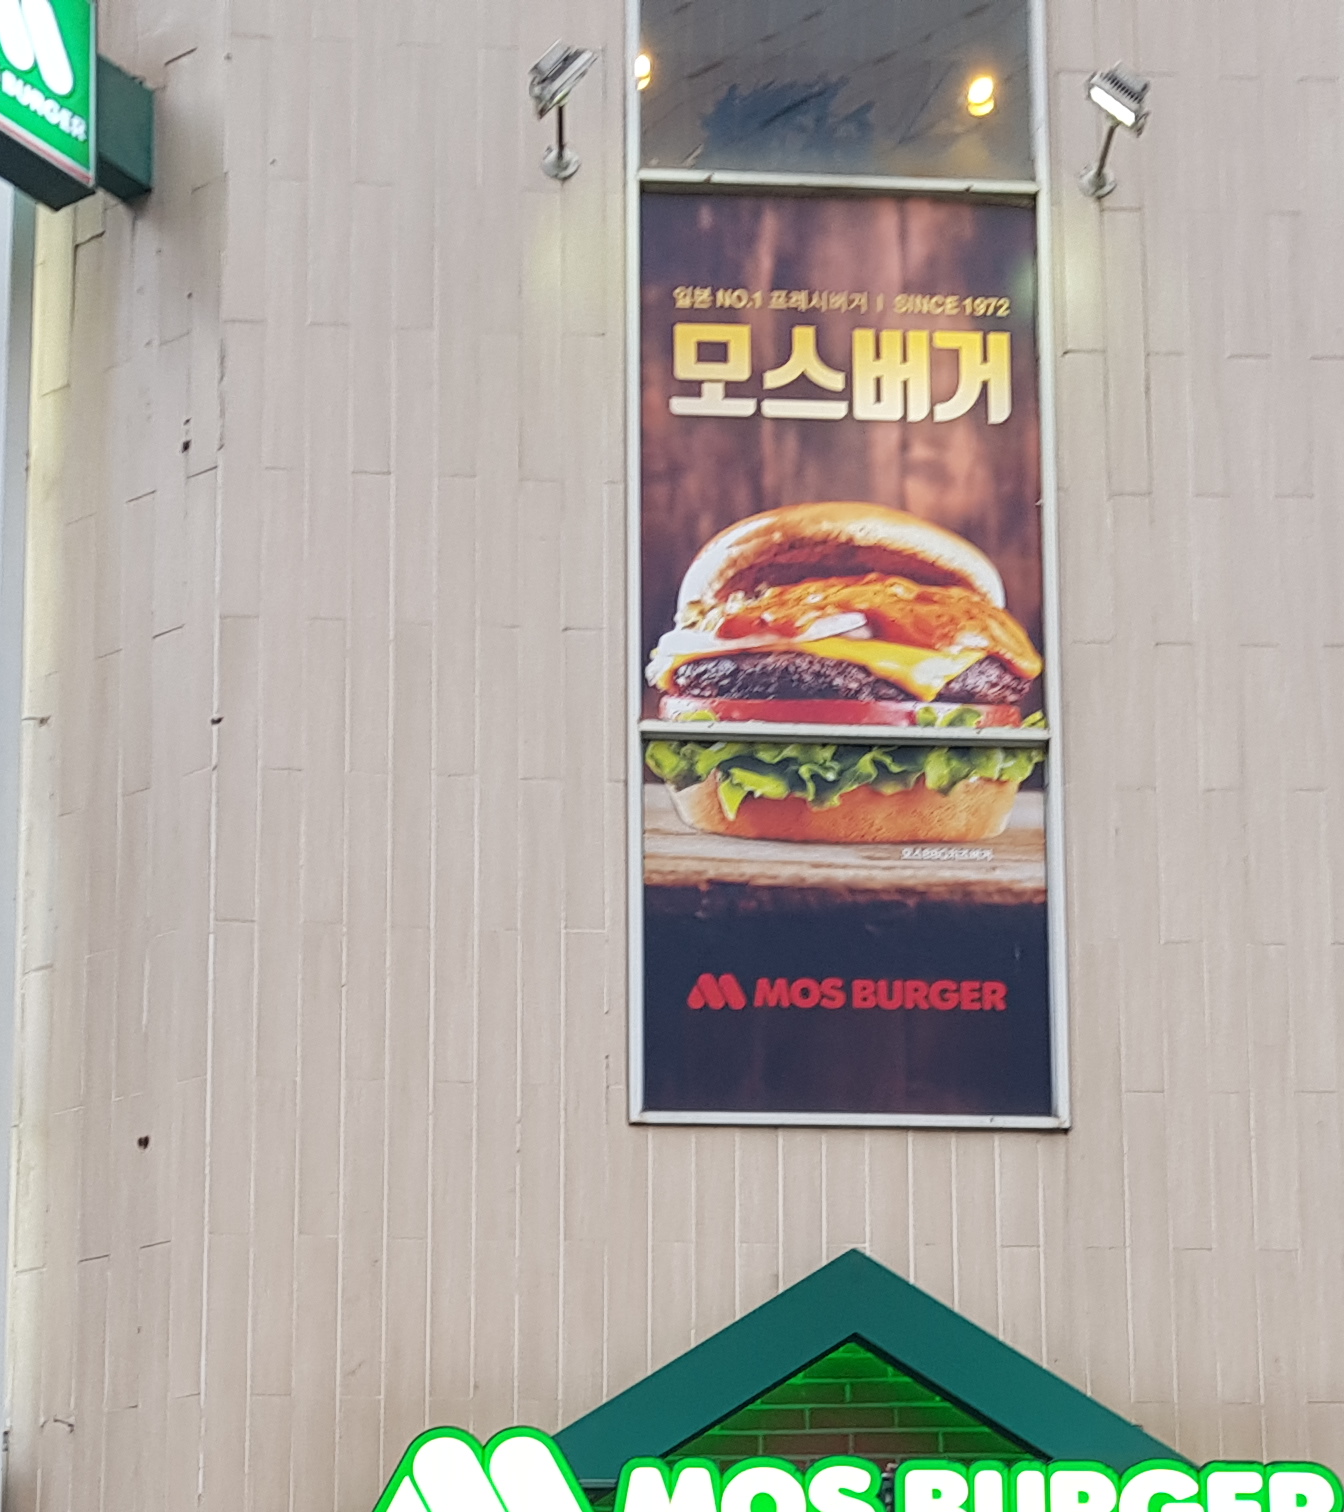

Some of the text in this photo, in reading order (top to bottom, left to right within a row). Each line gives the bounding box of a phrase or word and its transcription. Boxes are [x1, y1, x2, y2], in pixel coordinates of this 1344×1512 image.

[0, 66, 89, 142] BURGER
[714, 288, 762, 310] NO.1
[893, 293, 960, 314] SINCE
[963, 296, 1011, 317] 1972
[669, 322, 1013, 424] 모스버거
[754, 978, 846, 1009] MOS
[852, 979, 1008, 1011] BURGER
